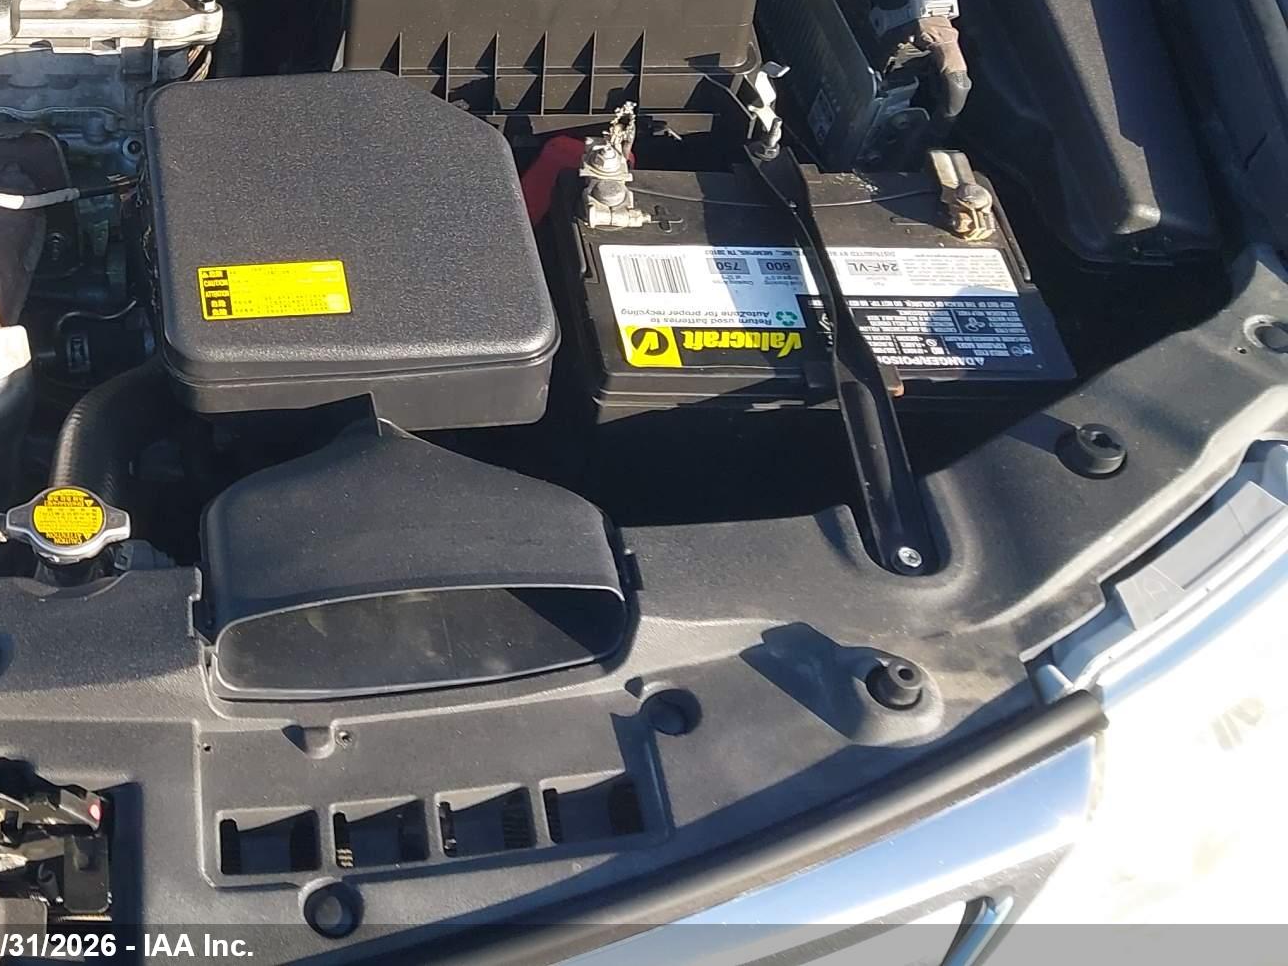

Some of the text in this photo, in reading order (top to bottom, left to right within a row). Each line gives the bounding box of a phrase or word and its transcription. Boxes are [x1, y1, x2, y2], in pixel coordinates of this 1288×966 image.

[715, 261, 741, 271] 750
[766, 262, 791, 271] 600
[847, 262, 899, 273] 24F-VL
[621, 308, 666, 317] recycling
[668, 309, 702, 317] proper
[721, 310, 770, 318] AutoZone
[663, 317, 708, 325] batteries
[711, 317, 735, 325] used
[738, 318, 772, 326] Return
[679, 330, 803, 358] Valucraft
